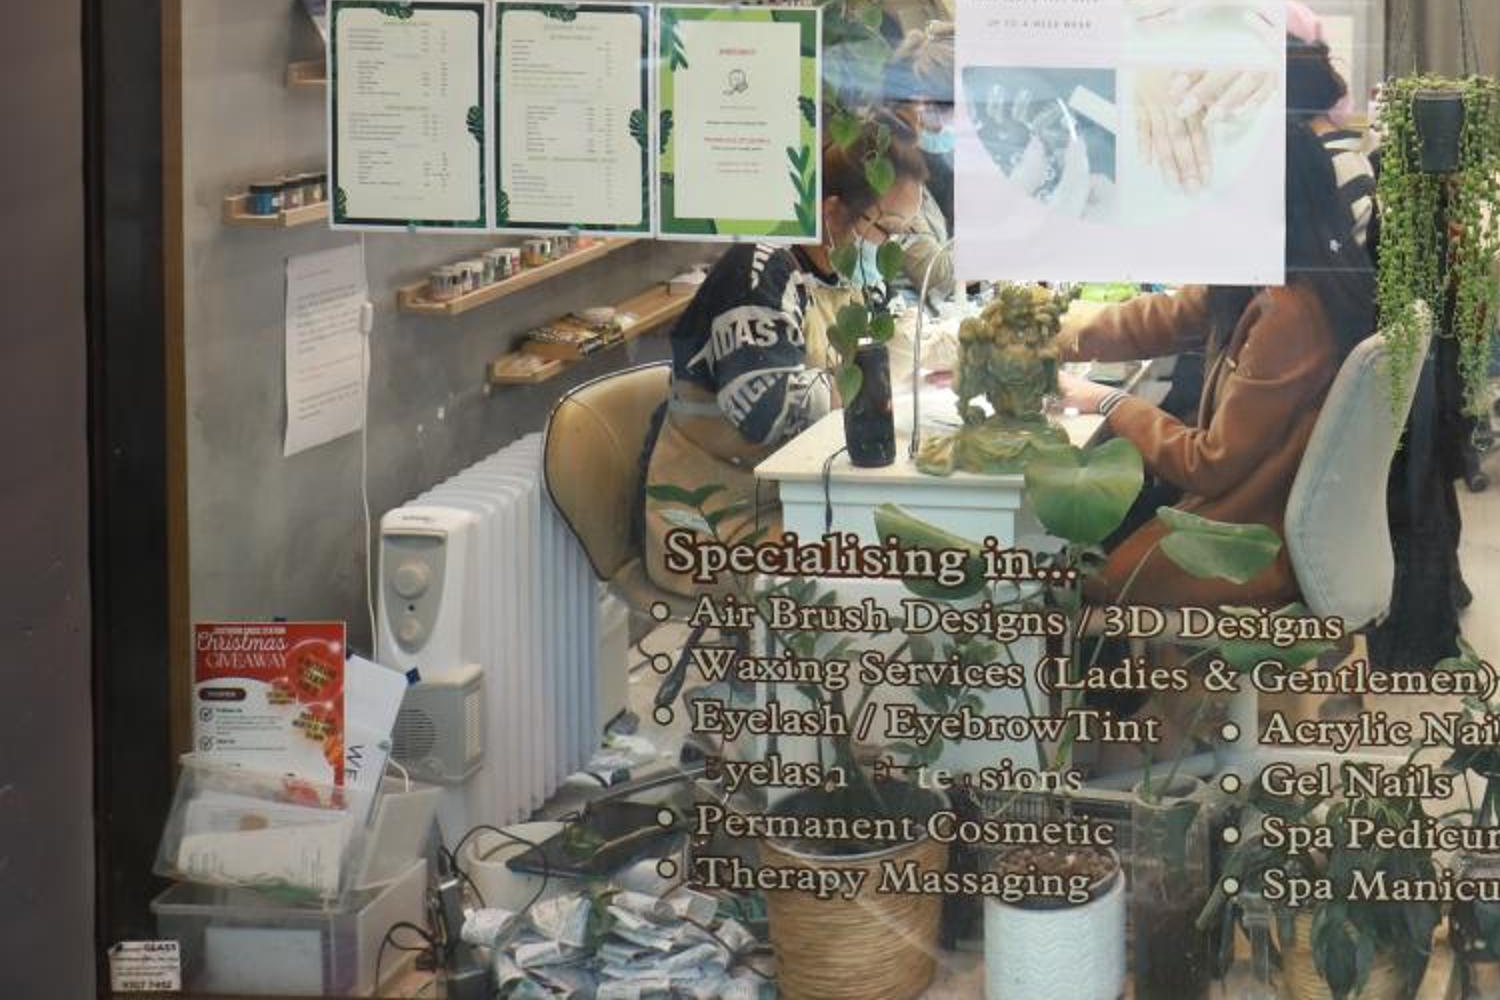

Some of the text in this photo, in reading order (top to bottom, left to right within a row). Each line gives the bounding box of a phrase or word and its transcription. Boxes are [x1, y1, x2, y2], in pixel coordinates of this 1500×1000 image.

[666, 530, 1078, 585] Specialising in...
[198, 631, 289, 652] Christmas
[687, 594, 758, 631] Air
[769, 595, 891, 633] Brush
[902, 598, 1068, 643] Designs
[1103, 603, 1166, 640] 3D
[1178, 604, 1344, 648] Designs
[206, 651, 288, 670] GIVEAWAY
[689, 647, 1499, 703] Waxing Services (Ladies & Gentlemen)
[691, 698, 1161, 747] Eyelash / Eyebrow Tint
[1258, 711, 1413, 754] Acrylic
[1260, 763, 1455, 800] Gel Nails
[693, 803, 1117, 847] Permanent Cosmetic
[1260, 815, 1335, 857] Spa
[696, 854, 1092, 903] Therapy Massaging
[1261, 868, 1335, 909] Spa
